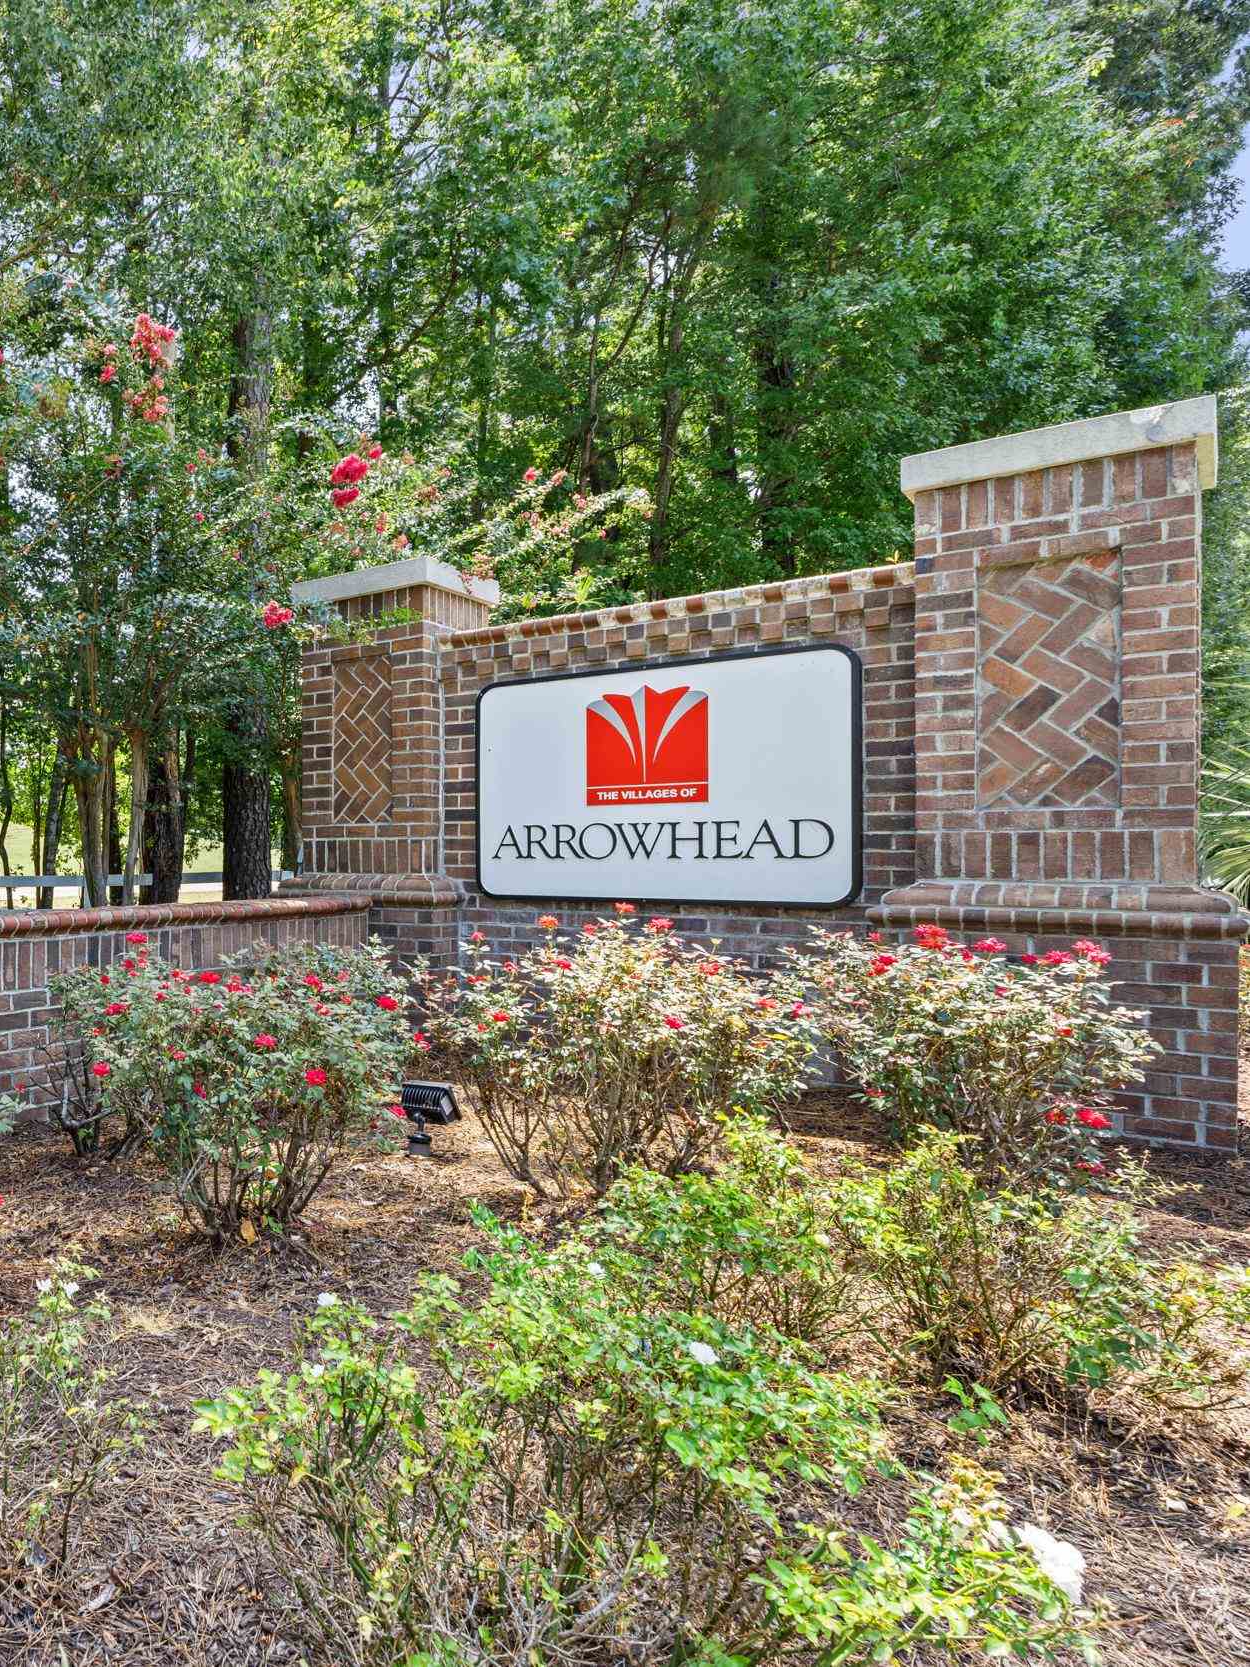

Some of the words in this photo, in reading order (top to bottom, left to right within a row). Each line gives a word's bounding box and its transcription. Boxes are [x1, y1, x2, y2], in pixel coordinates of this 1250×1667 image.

[597, 791, 619, 801] THE
[621, 789, 678, 800] VILLAGES
[680, 788, 697, 798] OF
[492, 818, 835, 861] ARROWHEAD
